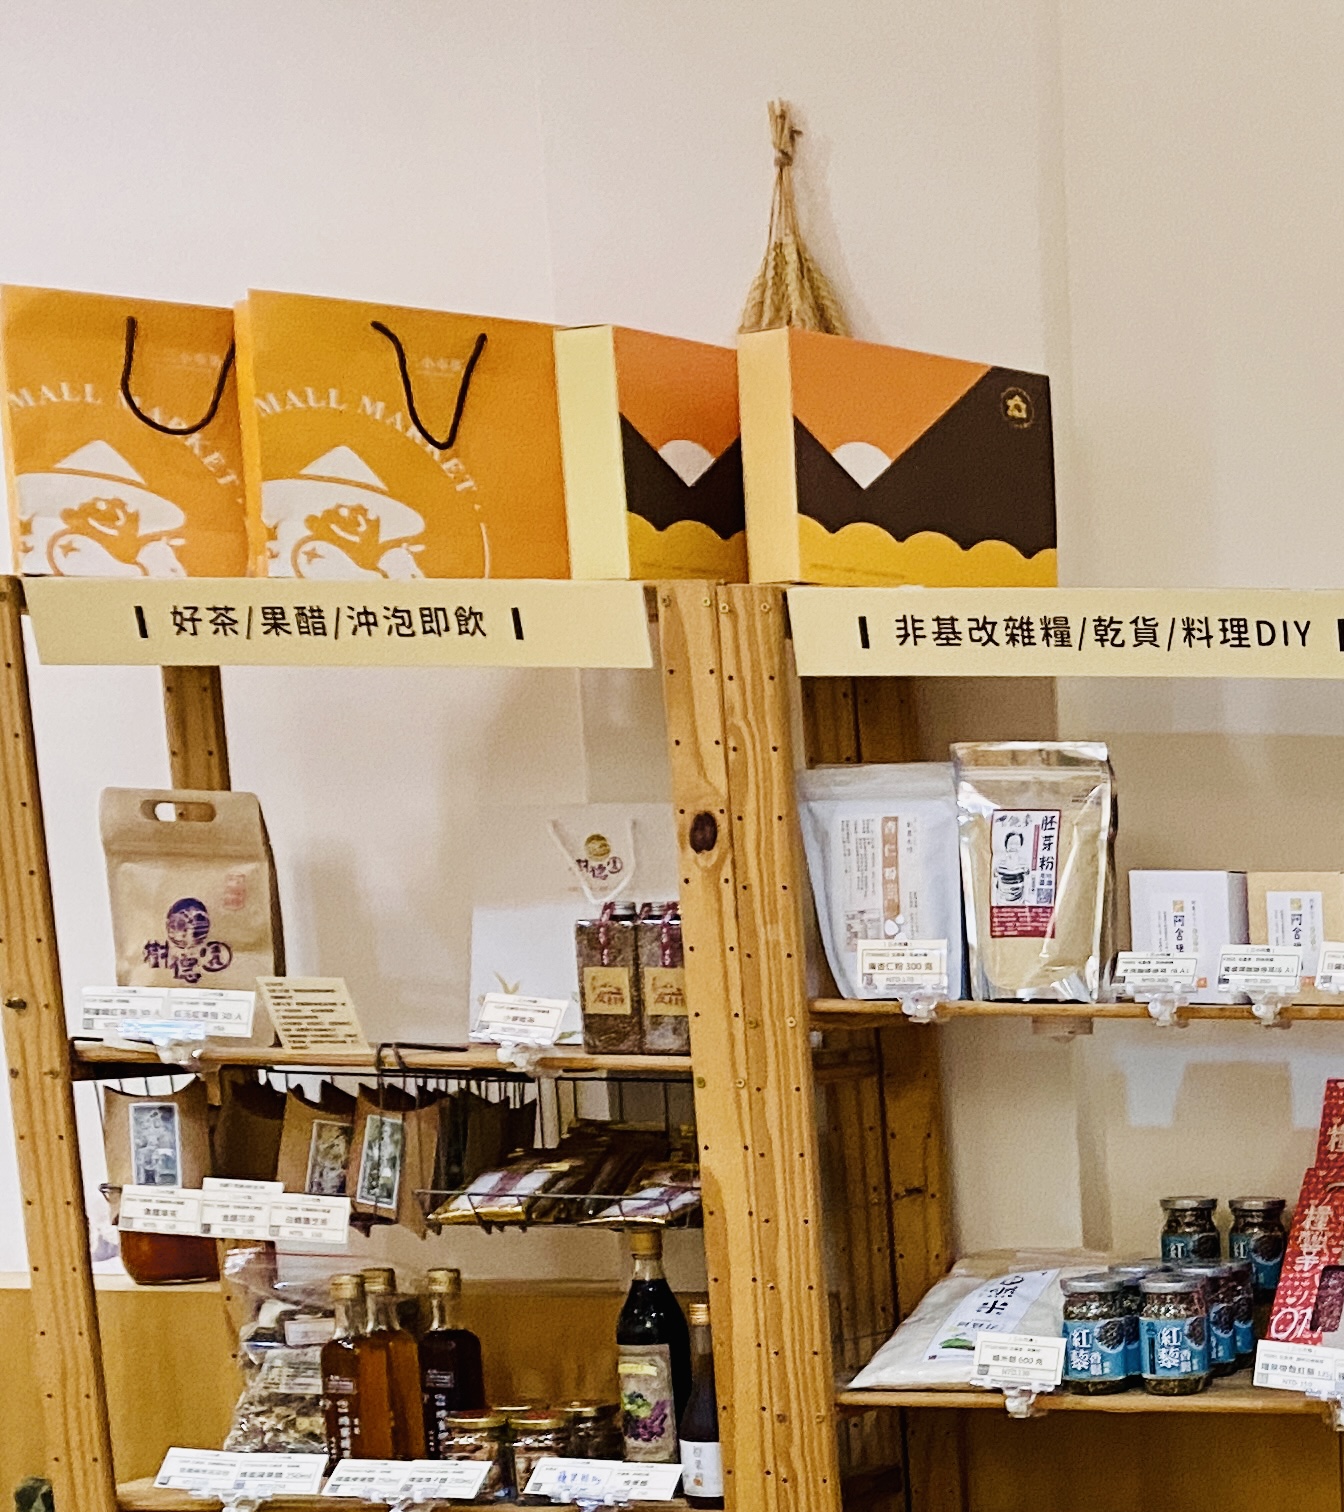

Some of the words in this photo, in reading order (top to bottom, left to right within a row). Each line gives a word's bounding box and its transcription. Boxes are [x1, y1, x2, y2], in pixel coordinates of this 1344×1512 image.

[255, 386, 346, 416] MALL
[171, 605, 487, 638] 好茶/果醋/沖泡即飲
[895, 614, 1313, 652] 非基改雜糧/乾貨/料理DIY
[1038, 815, 1058, 872] 胚芽粉
